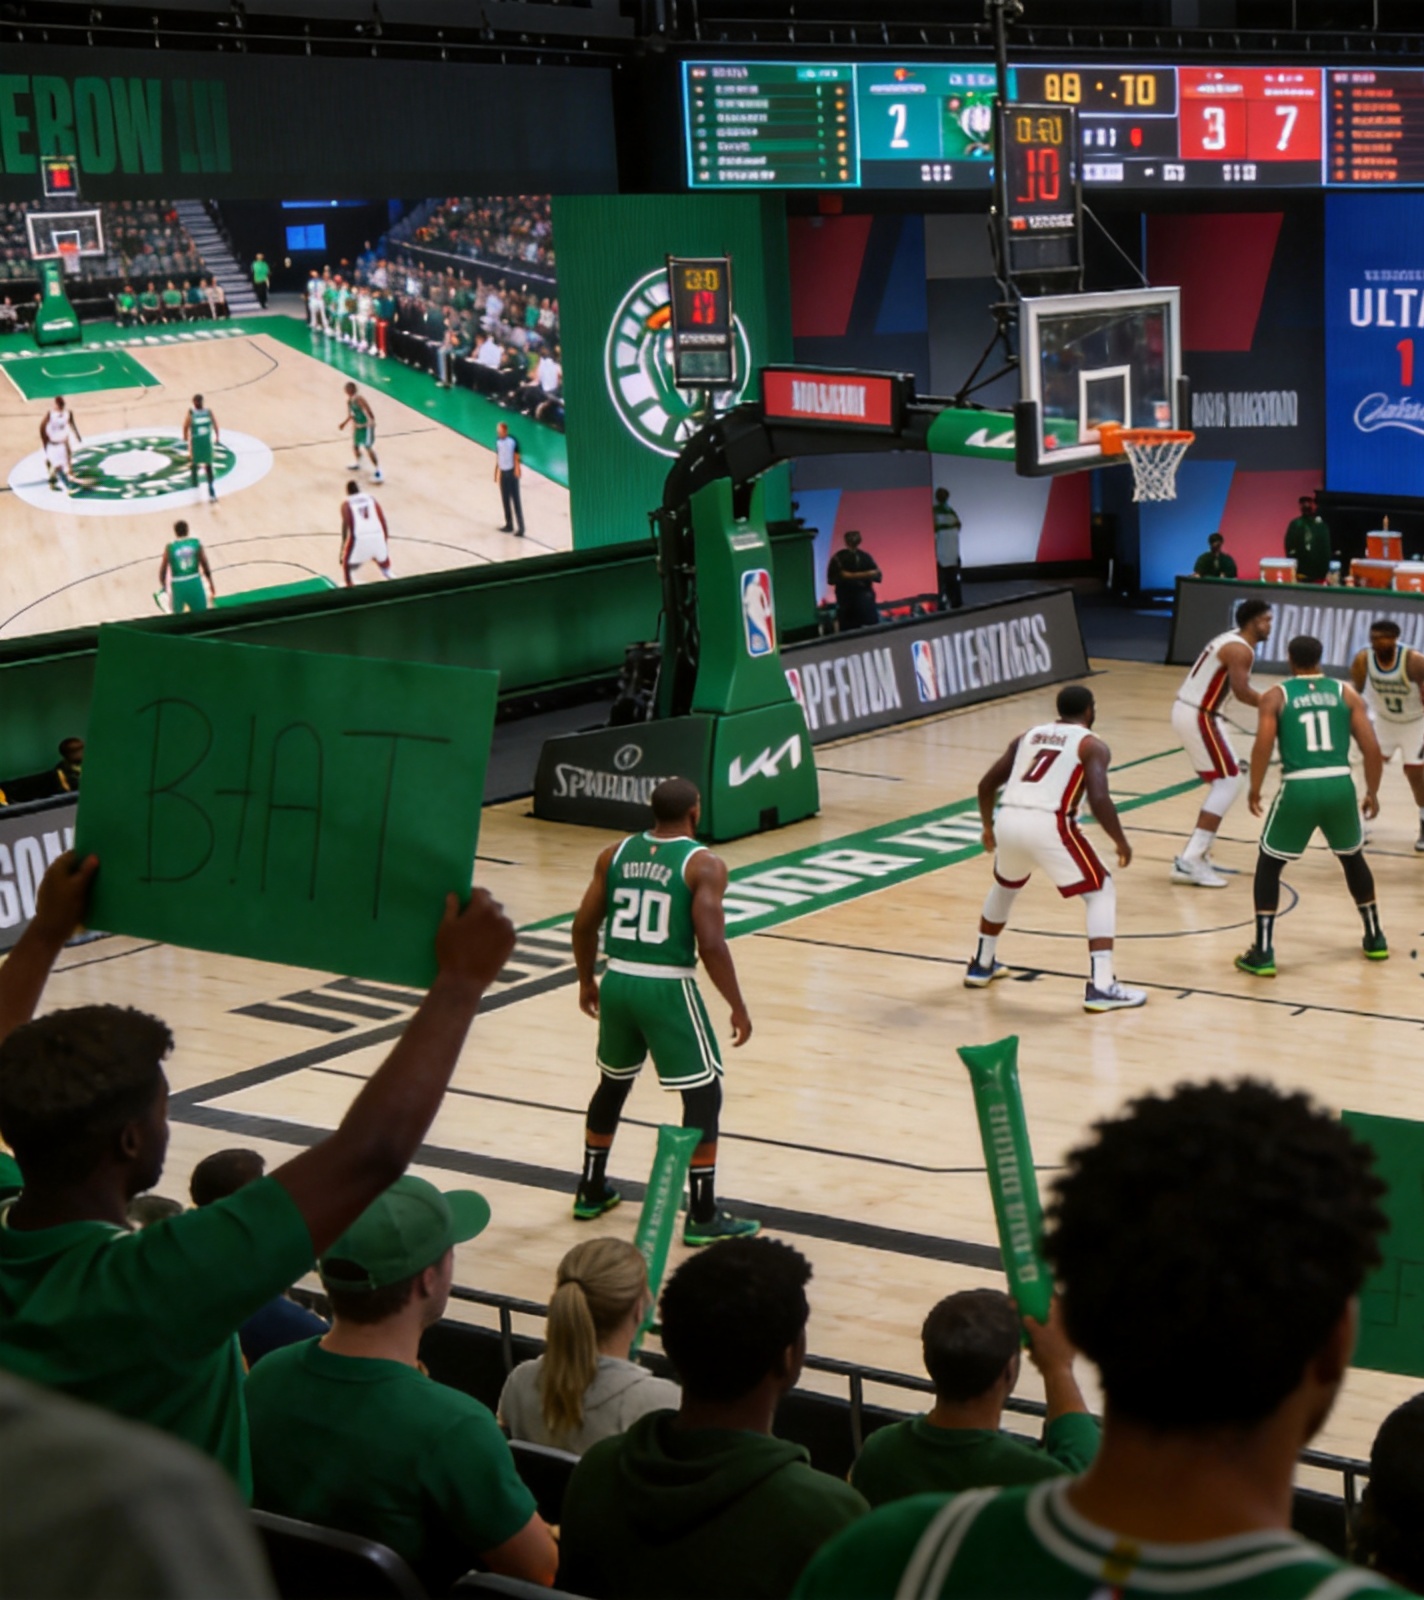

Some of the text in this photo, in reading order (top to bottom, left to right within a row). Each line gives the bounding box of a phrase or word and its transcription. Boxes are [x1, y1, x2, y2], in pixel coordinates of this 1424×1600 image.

[1202, 106, 1226, 151] 3
[1275, 104, 1298, 152] 7
[1396, 338, 1414, 387] 1
[1298, 710, 1335, 752] 11
[610, 887, 672, 945] 20
